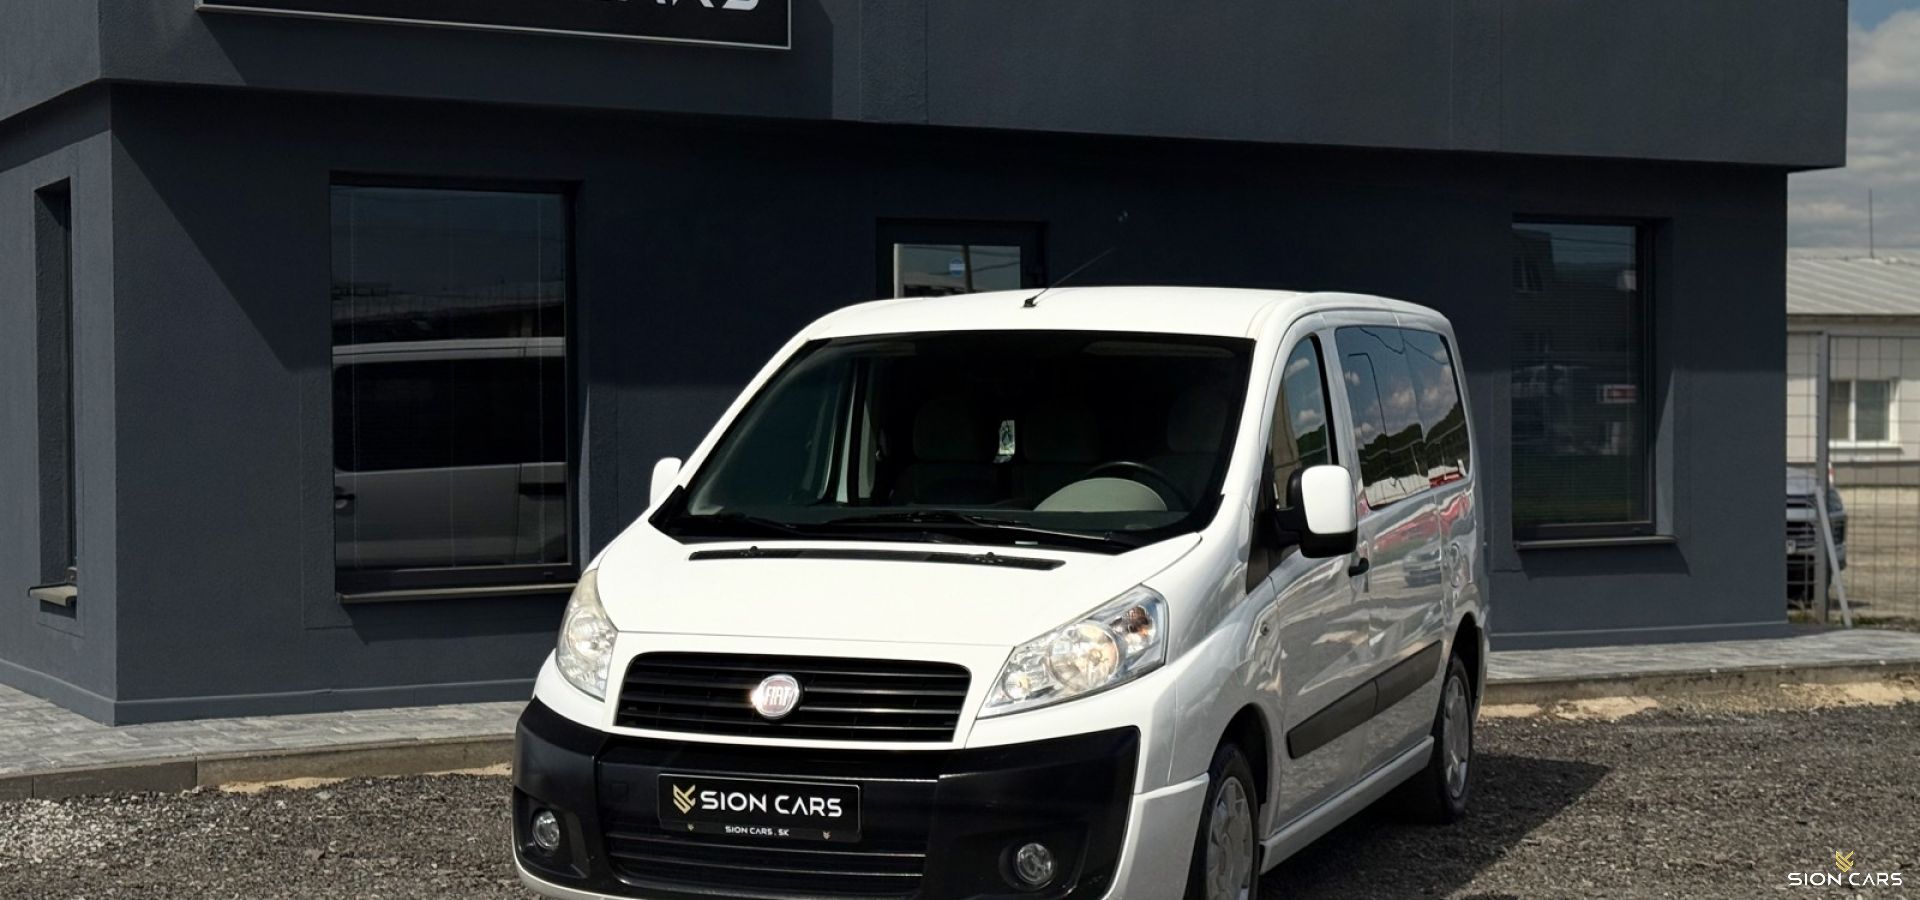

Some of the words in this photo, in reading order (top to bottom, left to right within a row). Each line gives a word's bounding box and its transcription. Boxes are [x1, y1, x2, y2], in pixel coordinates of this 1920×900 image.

[765, 685, 792, 706] FIAT
[700, 790, 767, 813] SION
[774, 795, 843, 817] CARS
[725, 825, 748, 834] SION
